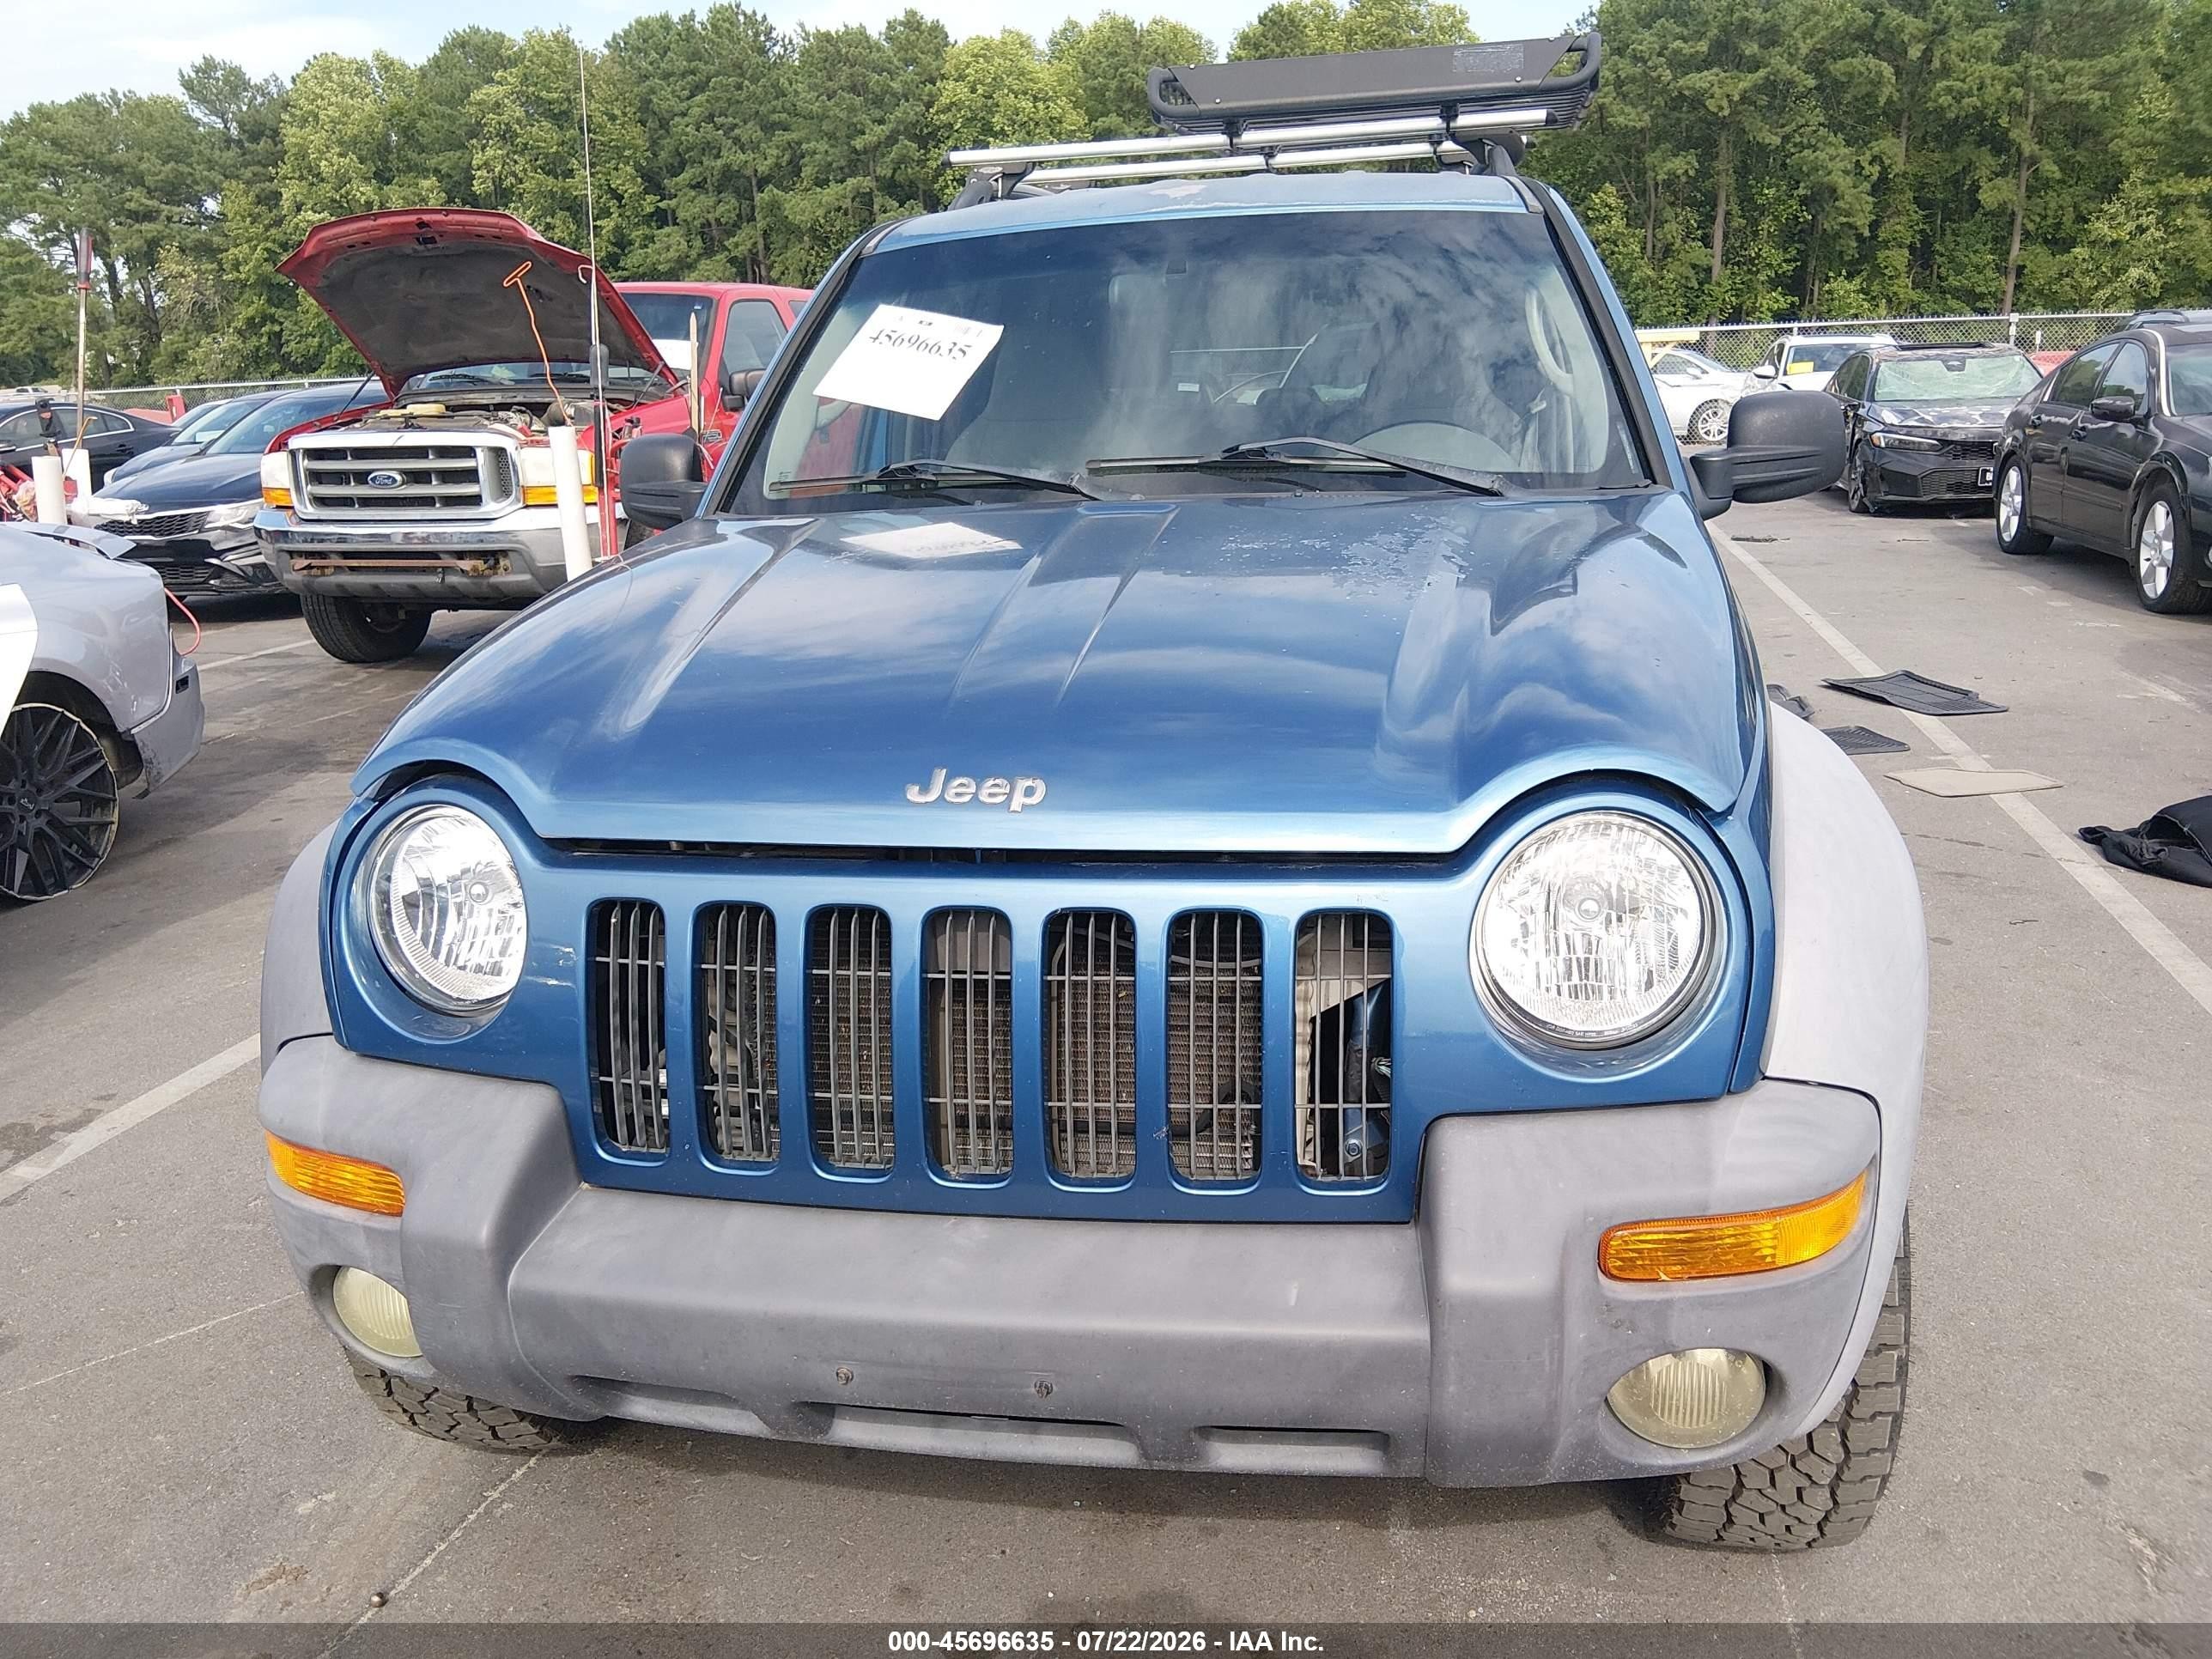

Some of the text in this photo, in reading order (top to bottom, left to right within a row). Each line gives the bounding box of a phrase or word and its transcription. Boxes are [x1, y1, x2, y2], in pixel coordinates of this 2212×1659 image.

[869, 328, 973, 360] 45696635
[375, 475, 393, 485] Ford
[906, 767, 1047, 812] Jeep
